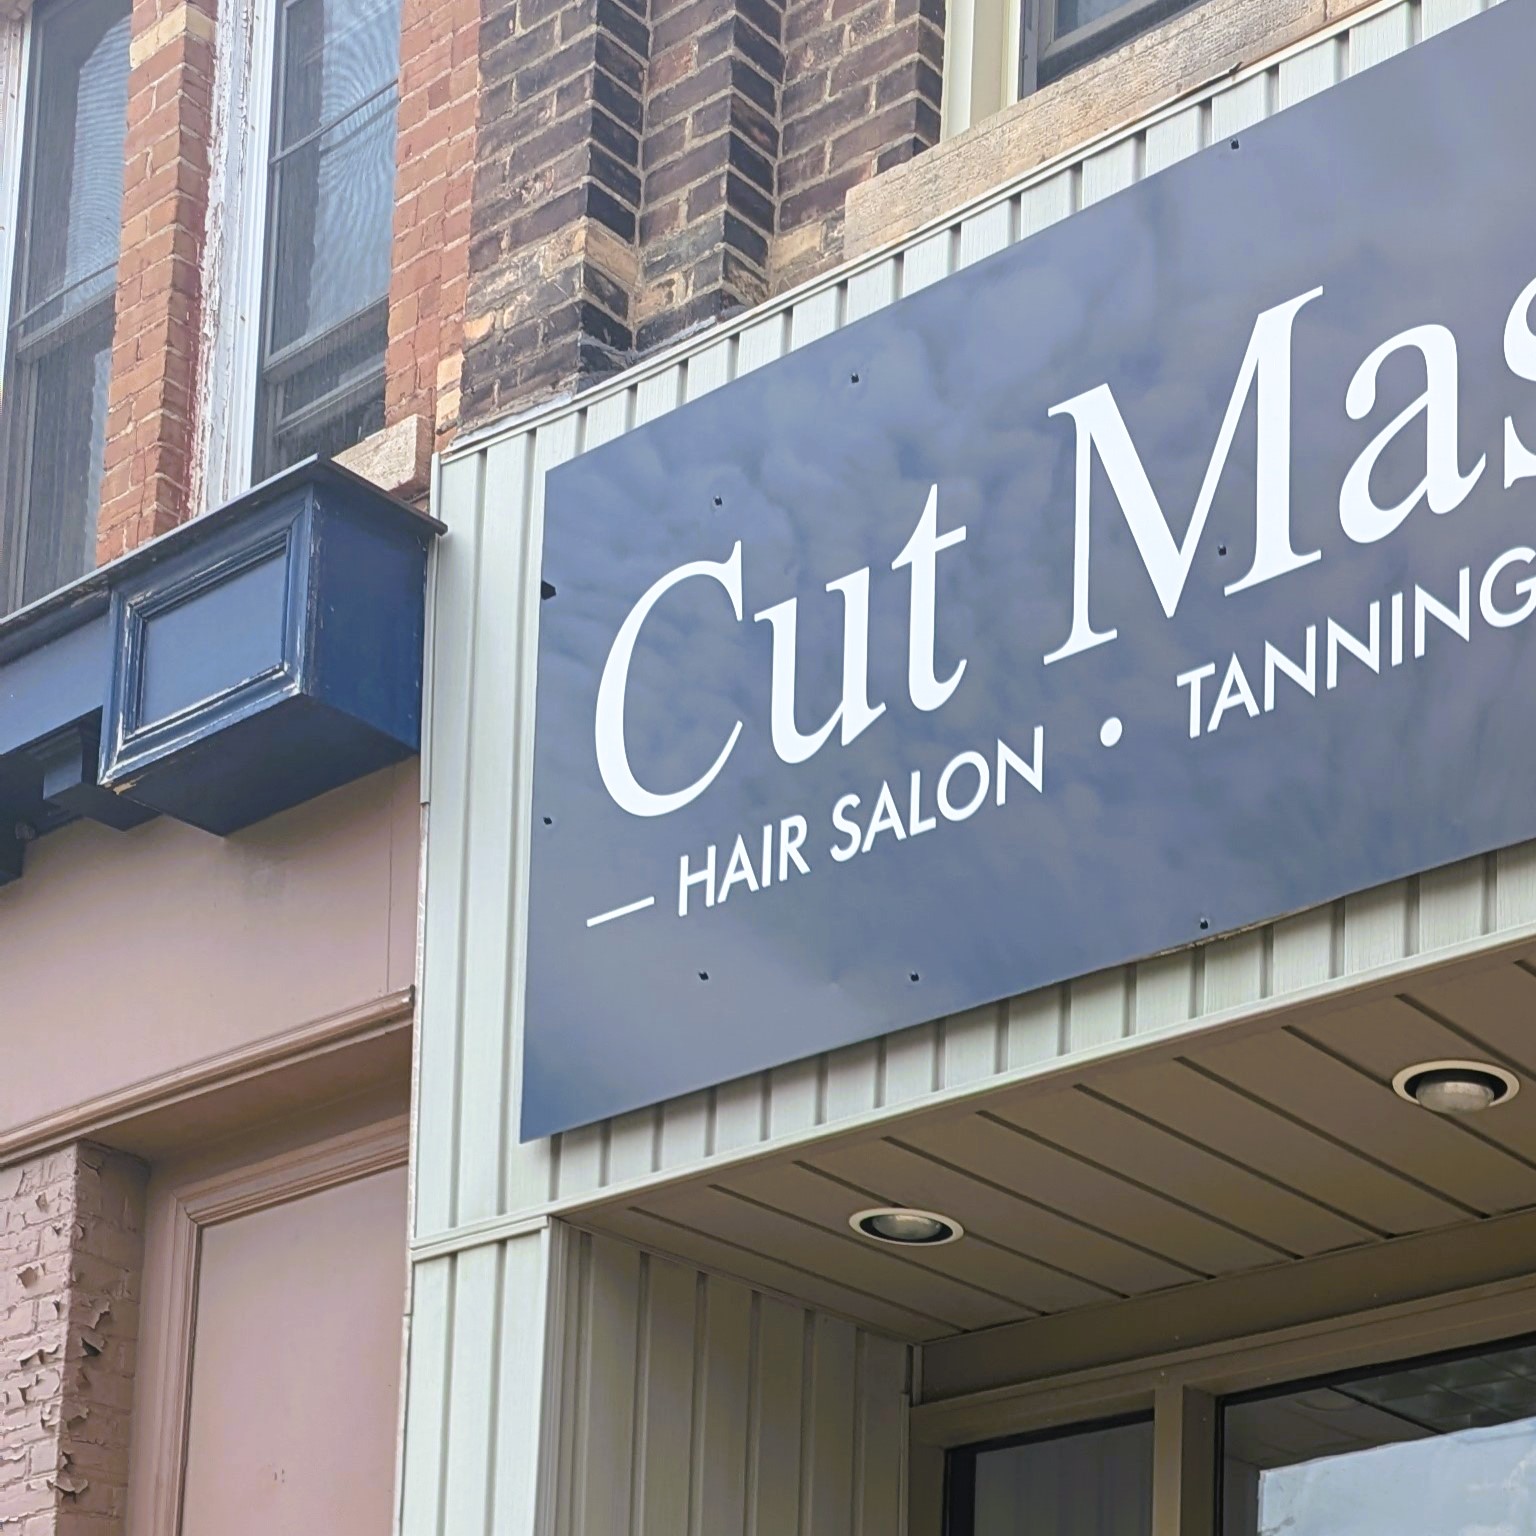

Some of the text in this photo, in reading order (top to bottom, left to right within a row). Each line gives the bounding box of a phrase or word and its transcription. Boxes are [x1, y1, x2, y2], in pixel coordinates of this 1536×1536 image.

[595, 483, 967, 817] Cut
[678, 814, 810, 917] HAIR
[829, 725, 1044, 863] SALON
